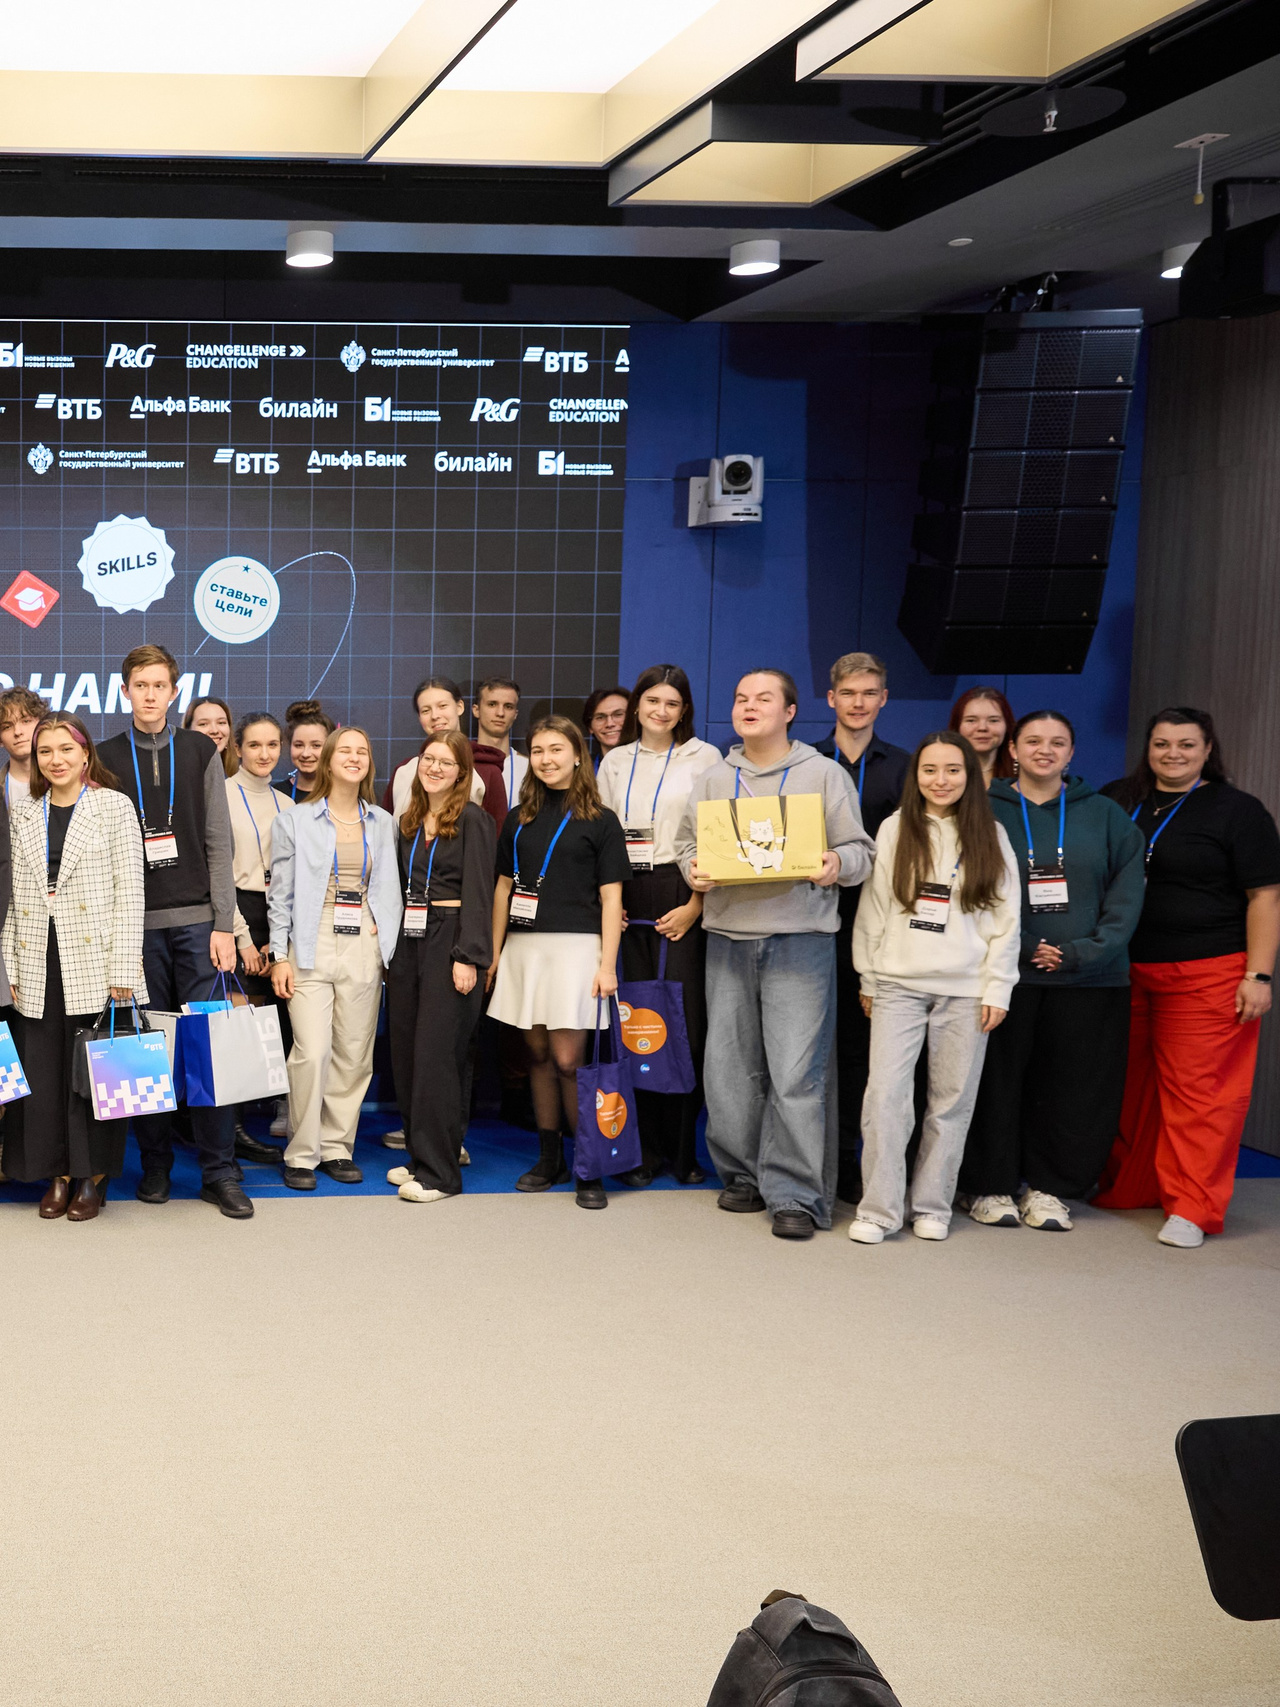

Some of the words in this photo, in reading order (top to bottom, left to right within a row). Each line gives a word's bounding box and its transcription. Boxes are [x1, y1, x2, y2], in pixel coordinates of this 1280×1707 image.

[105, 344, 156, 368] P&G
[187, 345, 286, 356] CHANGELLENGE
[372, 348, 458, 357] Санкт-Петербургский
[187, 357, 258, 368] EDUCATION
[372, 359, 442, 367] государственный
[443, 360, 495, 368] университет
[545, 352, 588, 372] ВТБ
[58, 399, 102, 419] ВТБ
[131, 396, 186, 416] Альфа
[189, 397, 231, 412] Банк
[260, 397, 337, 418] билайн
[470, 398, 520, 422] P&G
[549, 411, 619, 422] EDUCATION
[59, 450, 147, 460] Санкт-Петербургский
[59, 461, 130, 469] государственный
[236, 453, 279, 474] ВТБ
[308, 450, 363, 470] Альфа
[365, 451, 406, 467] Банк
[435, 451, 511, 472] билайн
[97, 552, 158, 577] SKILLS
[210, 583, 268, 607] ставьте
[215, 599, 253, 618] цели
[150, 1043, 163, 1051] ВТБ
[255, 1017, 288, 1091] ВТБ
